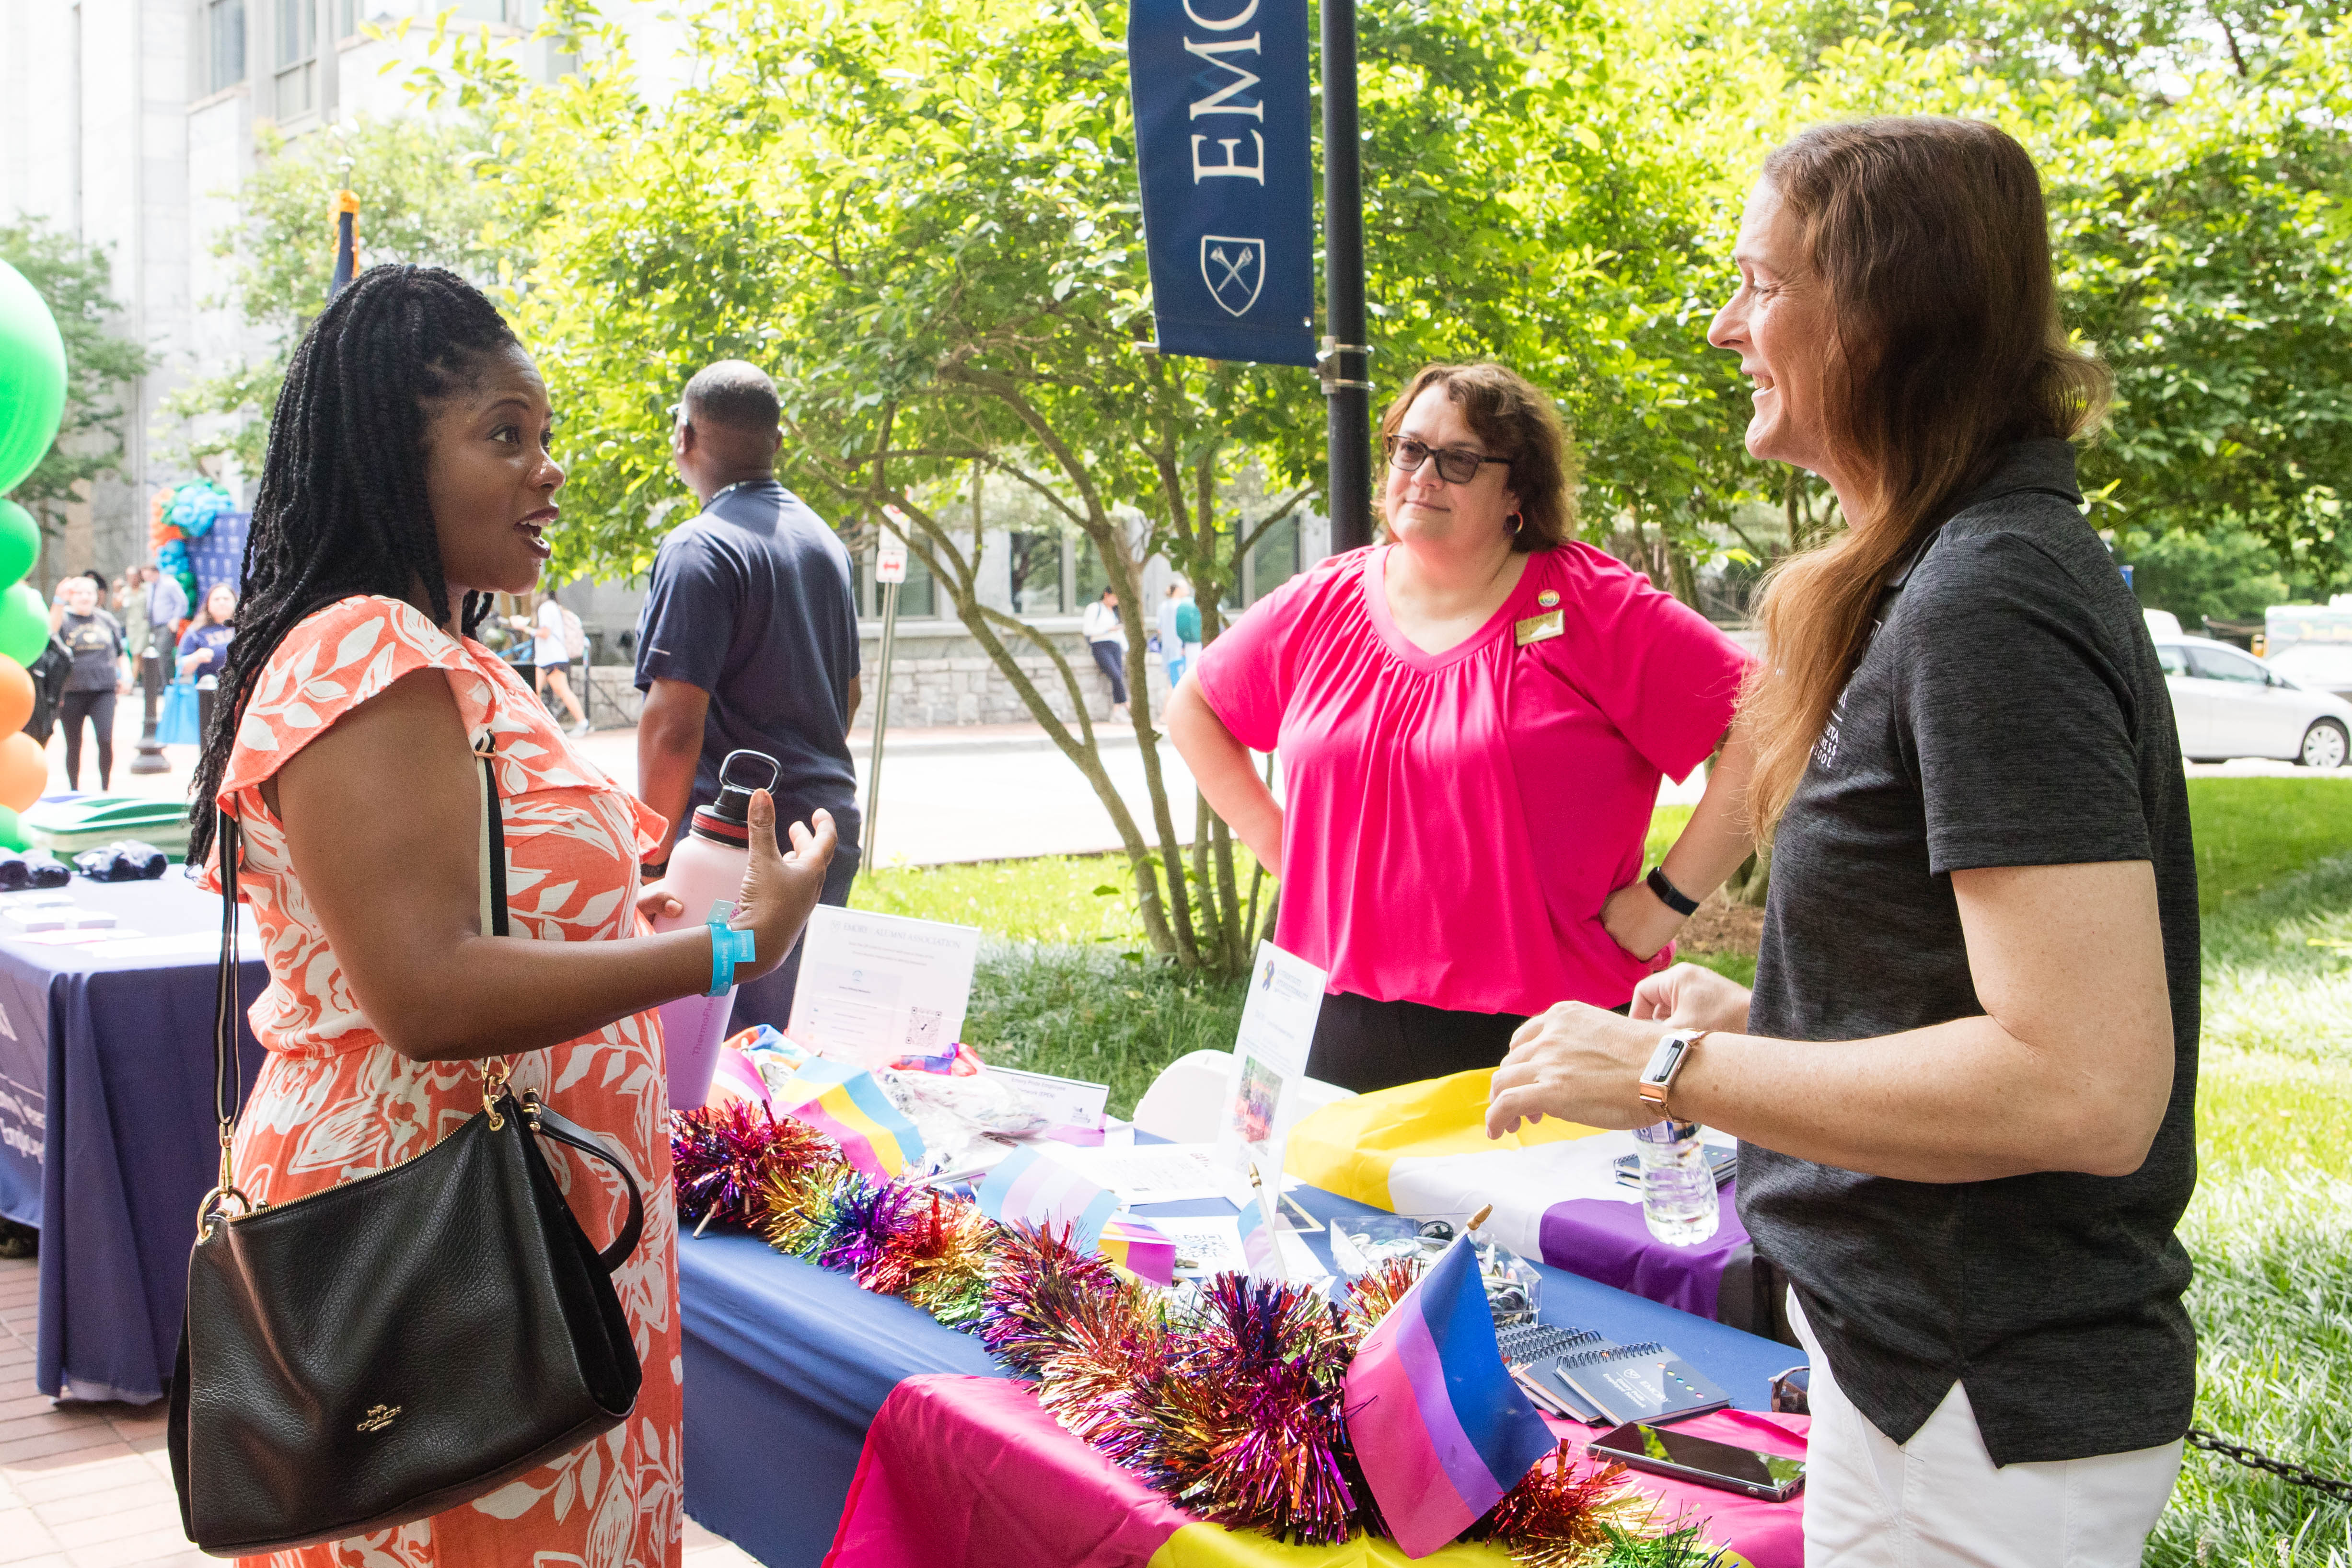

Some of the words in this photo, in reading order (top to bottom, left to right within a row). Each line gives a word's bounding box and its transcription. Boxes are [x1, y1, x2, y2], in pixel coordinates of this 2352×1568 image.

[844, 922, 867, 934] EMORY
[874, 928, 905, 940] ALUMNI
[907, 933, 961, 949] ASSOCIATION
[692, 997, 714, 1056] ThermoFlas
[1011, 1077, 1026, 1085] Emory
[1640, 1380, 1672, 1403] EMORY
[357, 1405, 402, 1431] COACH
